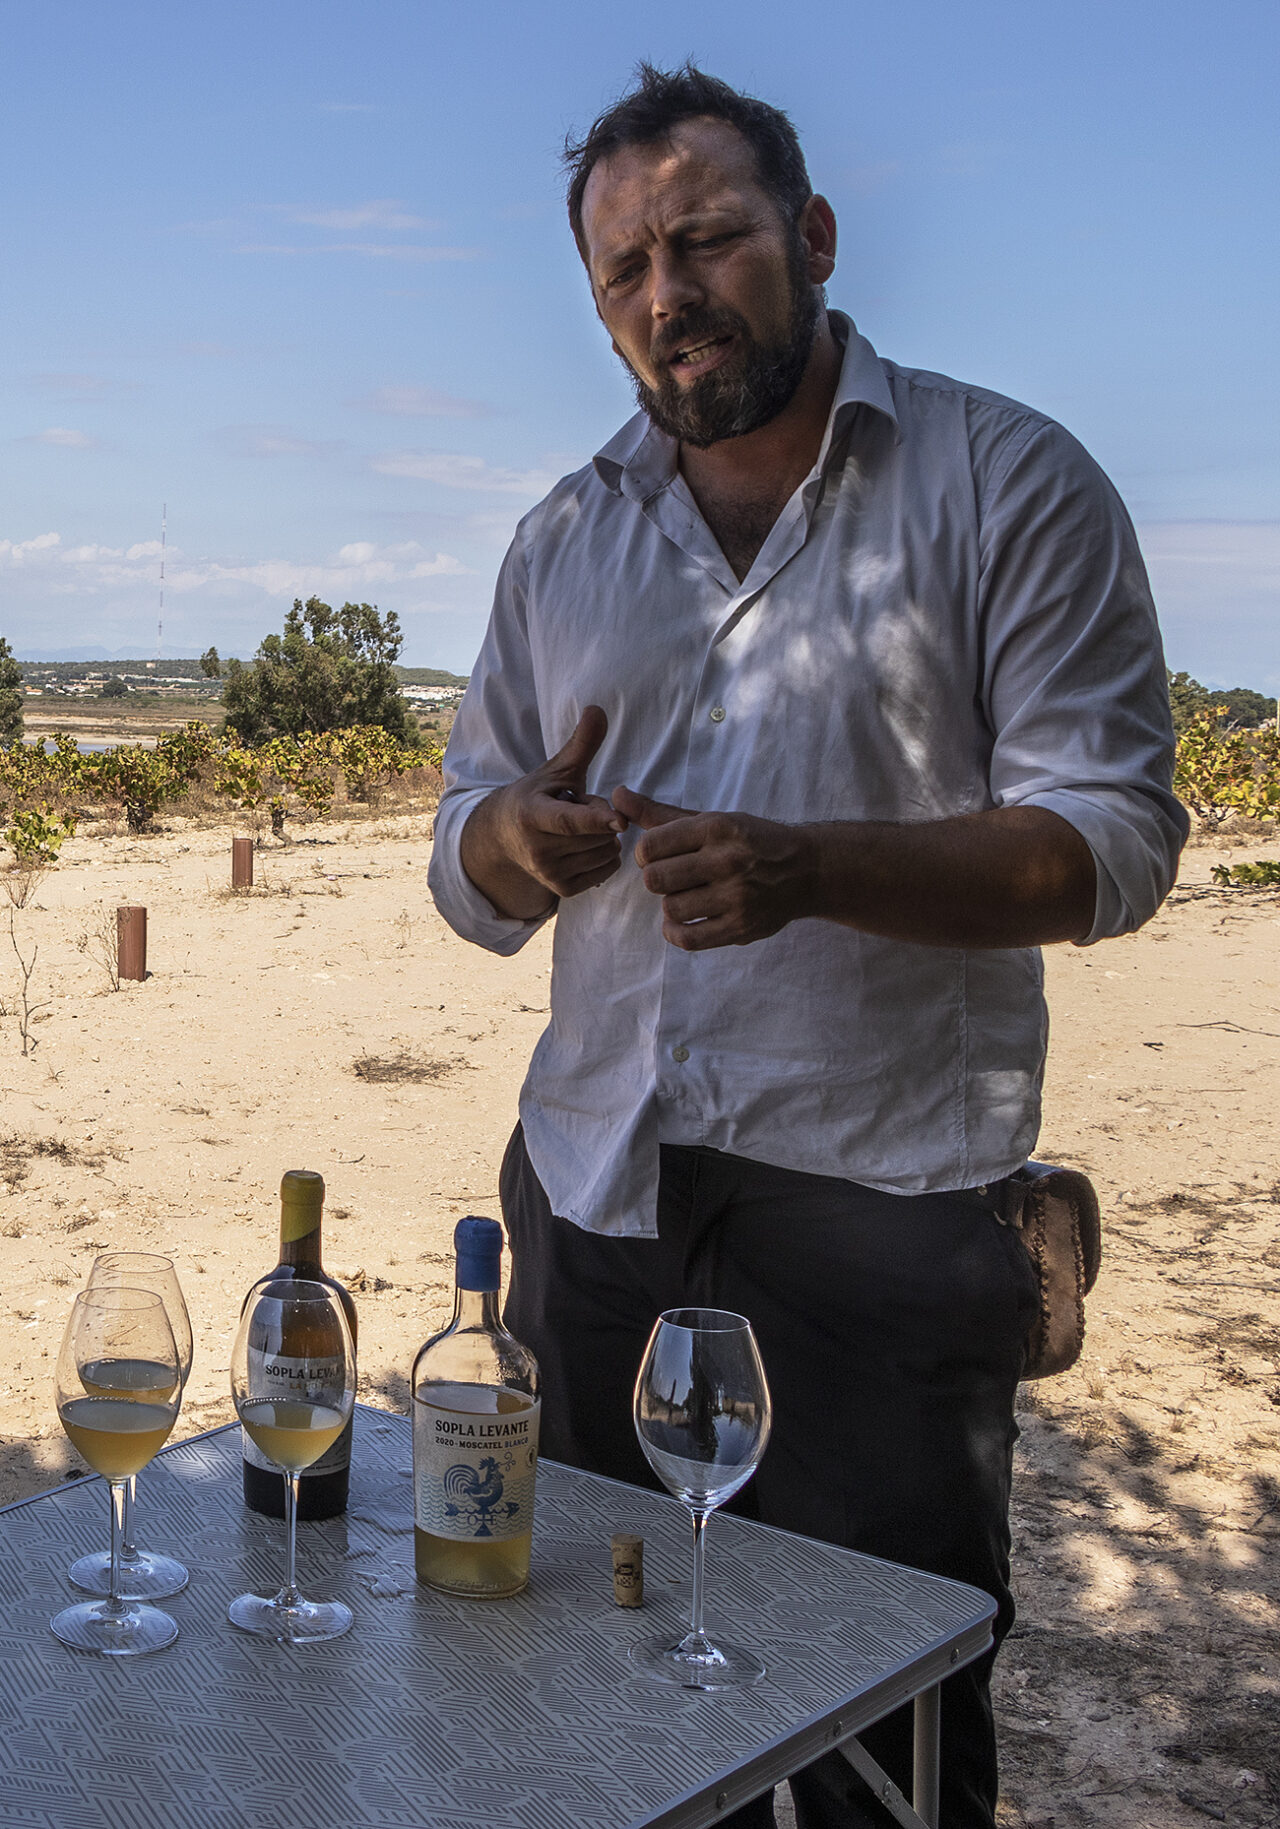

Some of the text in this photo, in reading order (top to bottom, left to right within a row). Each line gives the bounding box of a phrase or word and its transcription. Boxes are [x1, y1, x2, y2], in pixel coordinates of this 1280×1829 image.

[265, 1364, 305, 1379] SOPLA
[435, 1419, 529, 1437] SOPLA LEVANTE
[435, 1436, 529, 1449] 2020 MOSCATEL BLANCO
